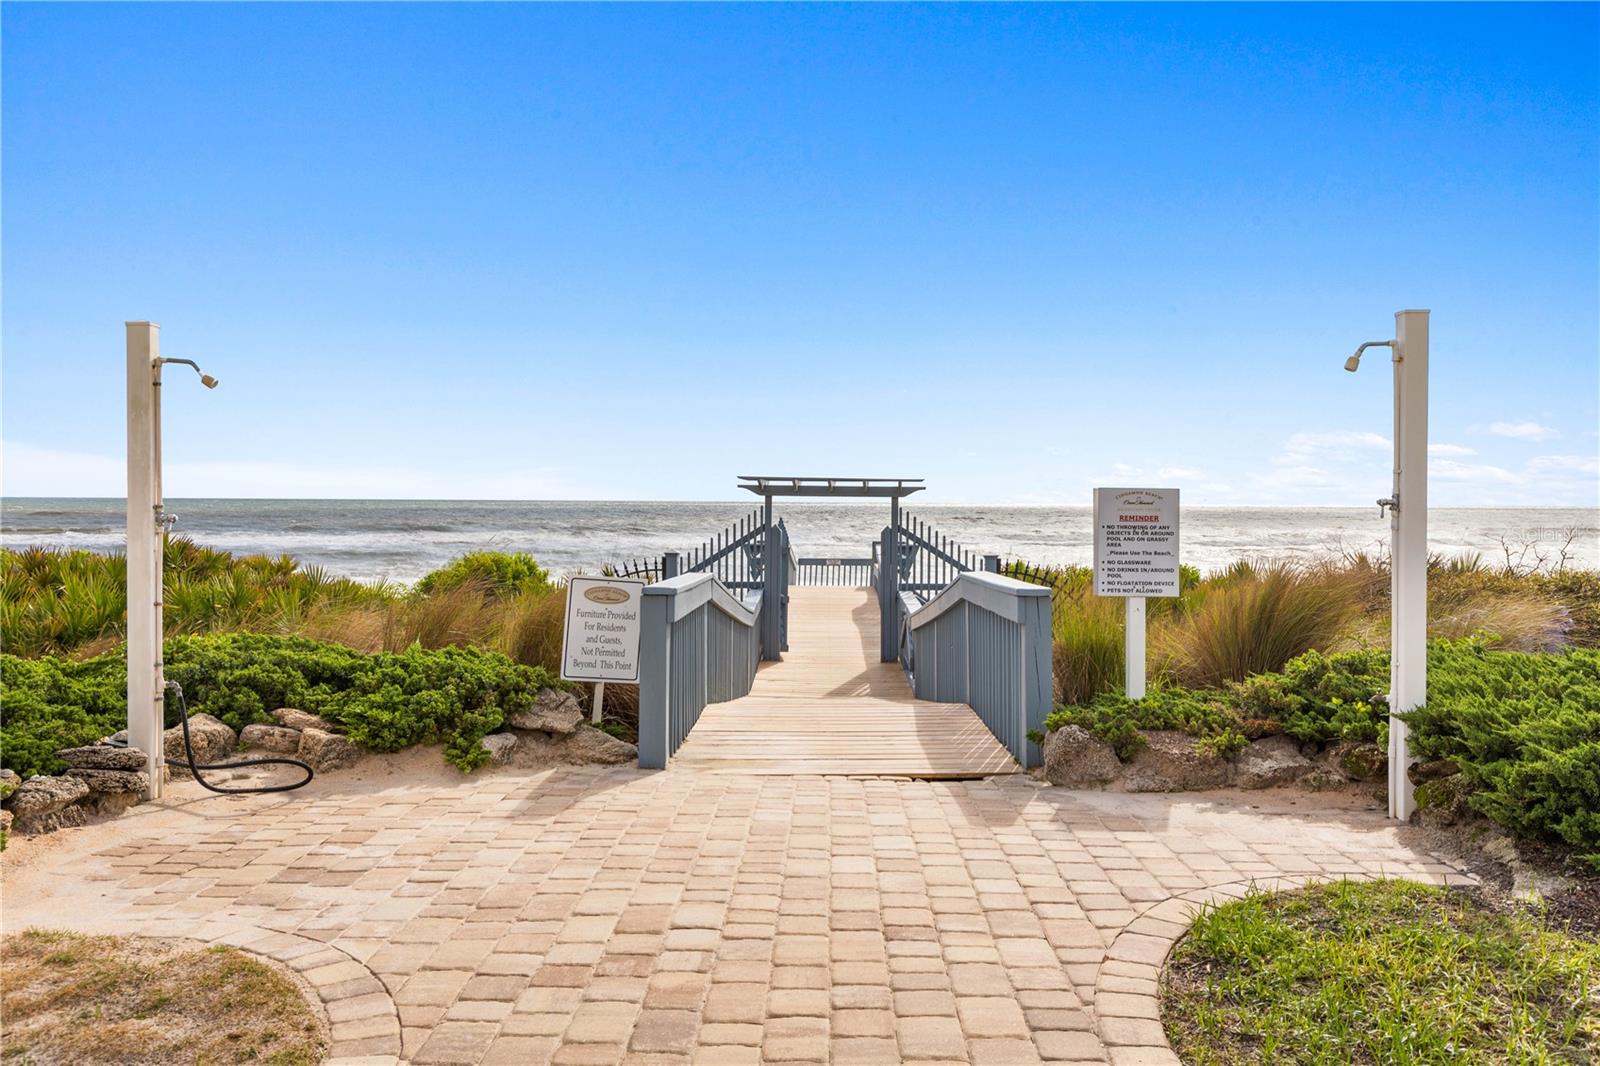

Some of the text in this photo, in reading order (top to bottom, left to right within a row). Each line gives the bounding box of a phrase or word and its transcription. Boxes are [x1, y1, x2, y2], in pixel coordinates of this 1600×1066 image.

[576, 608, 636, 620] Furniture Provided
[584, 622, 626, 632] For Residents
[586, 635, 622, 645] and Guests,
[581, 647, 625, 657] Not Permitted
[573, 659, 631, 670] Beyond This Point
